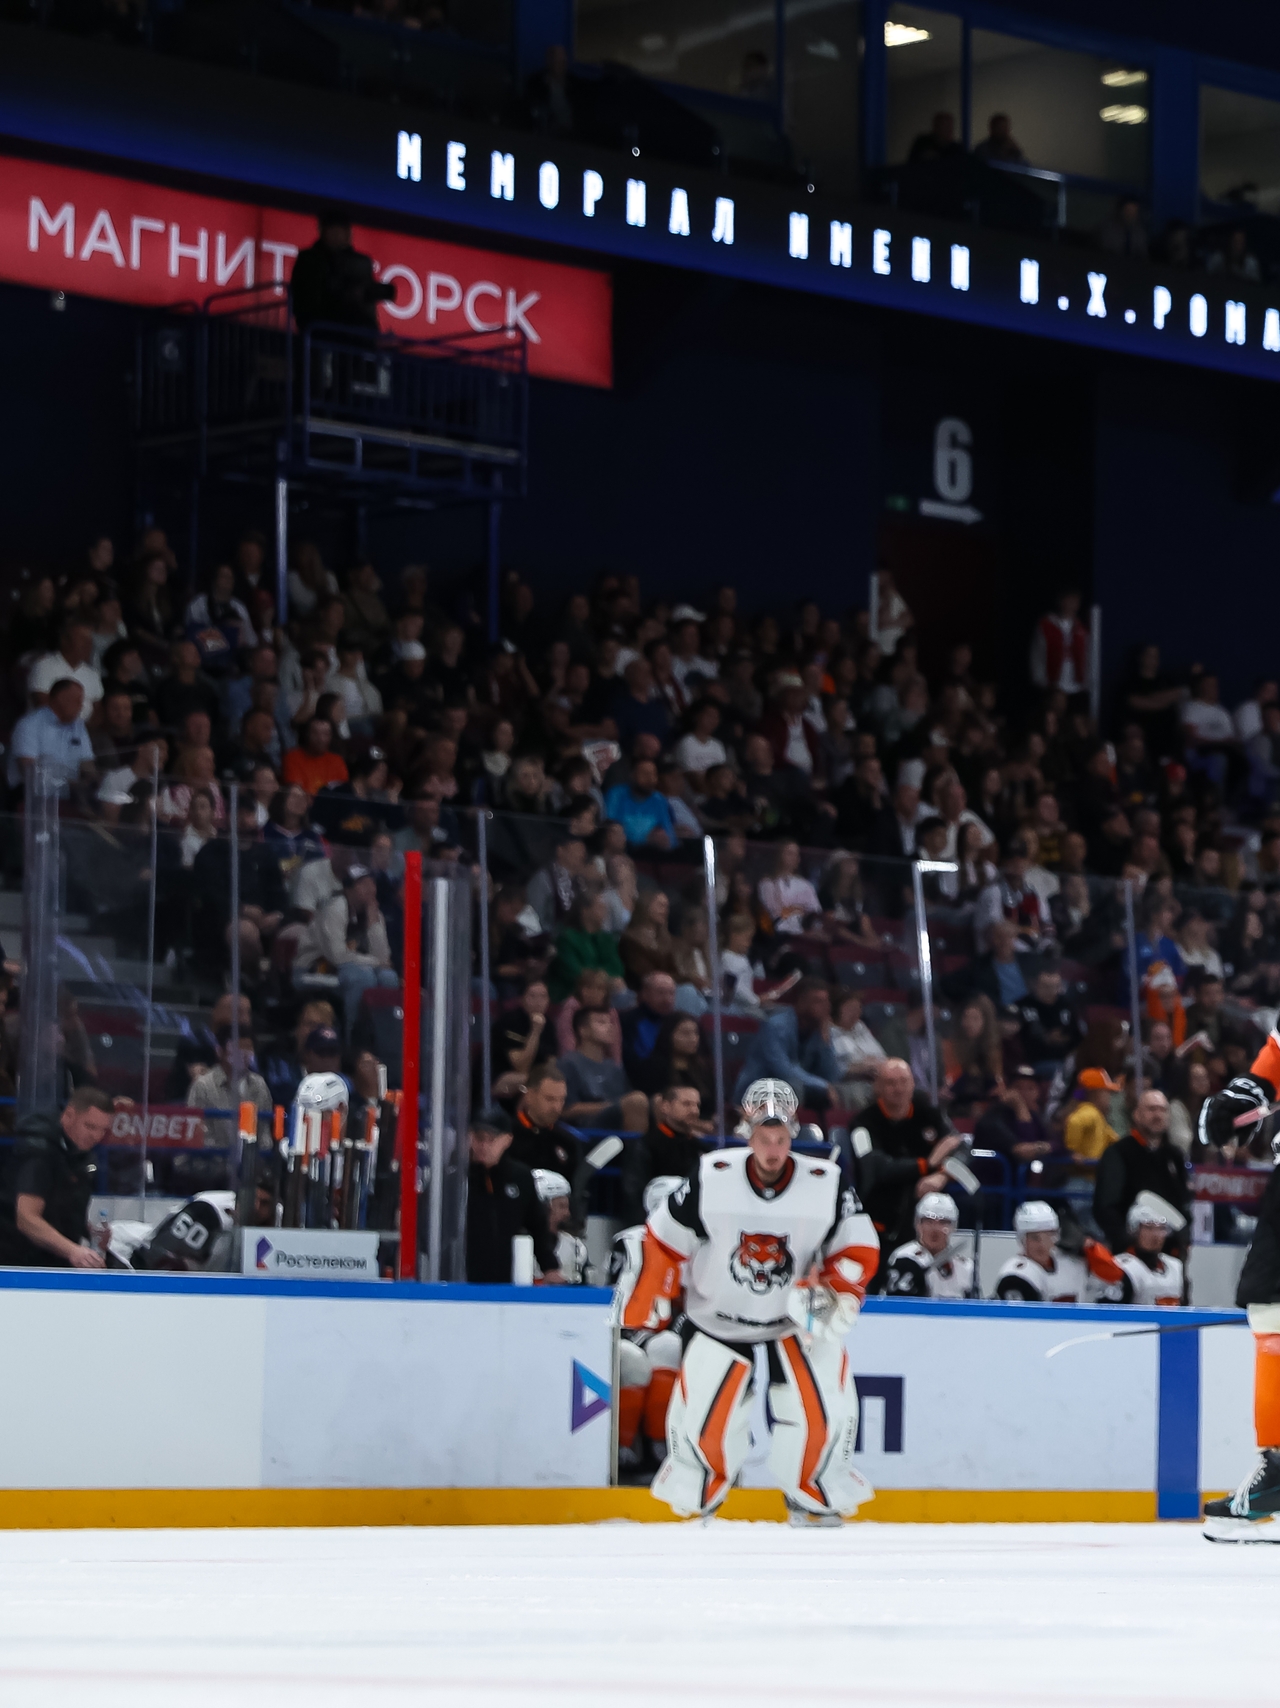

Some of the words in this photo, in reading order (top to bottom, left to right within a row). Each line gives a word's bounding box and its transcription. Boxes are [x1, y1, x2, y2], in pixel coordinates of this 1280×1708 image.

[27, 195, 541, 344] МАГНИТОРСК
[934, 416, 973, 503] 6
[112, 1112, 201, 1140] ONBET
[276, 1252, 367, 1271] Ростелеком
